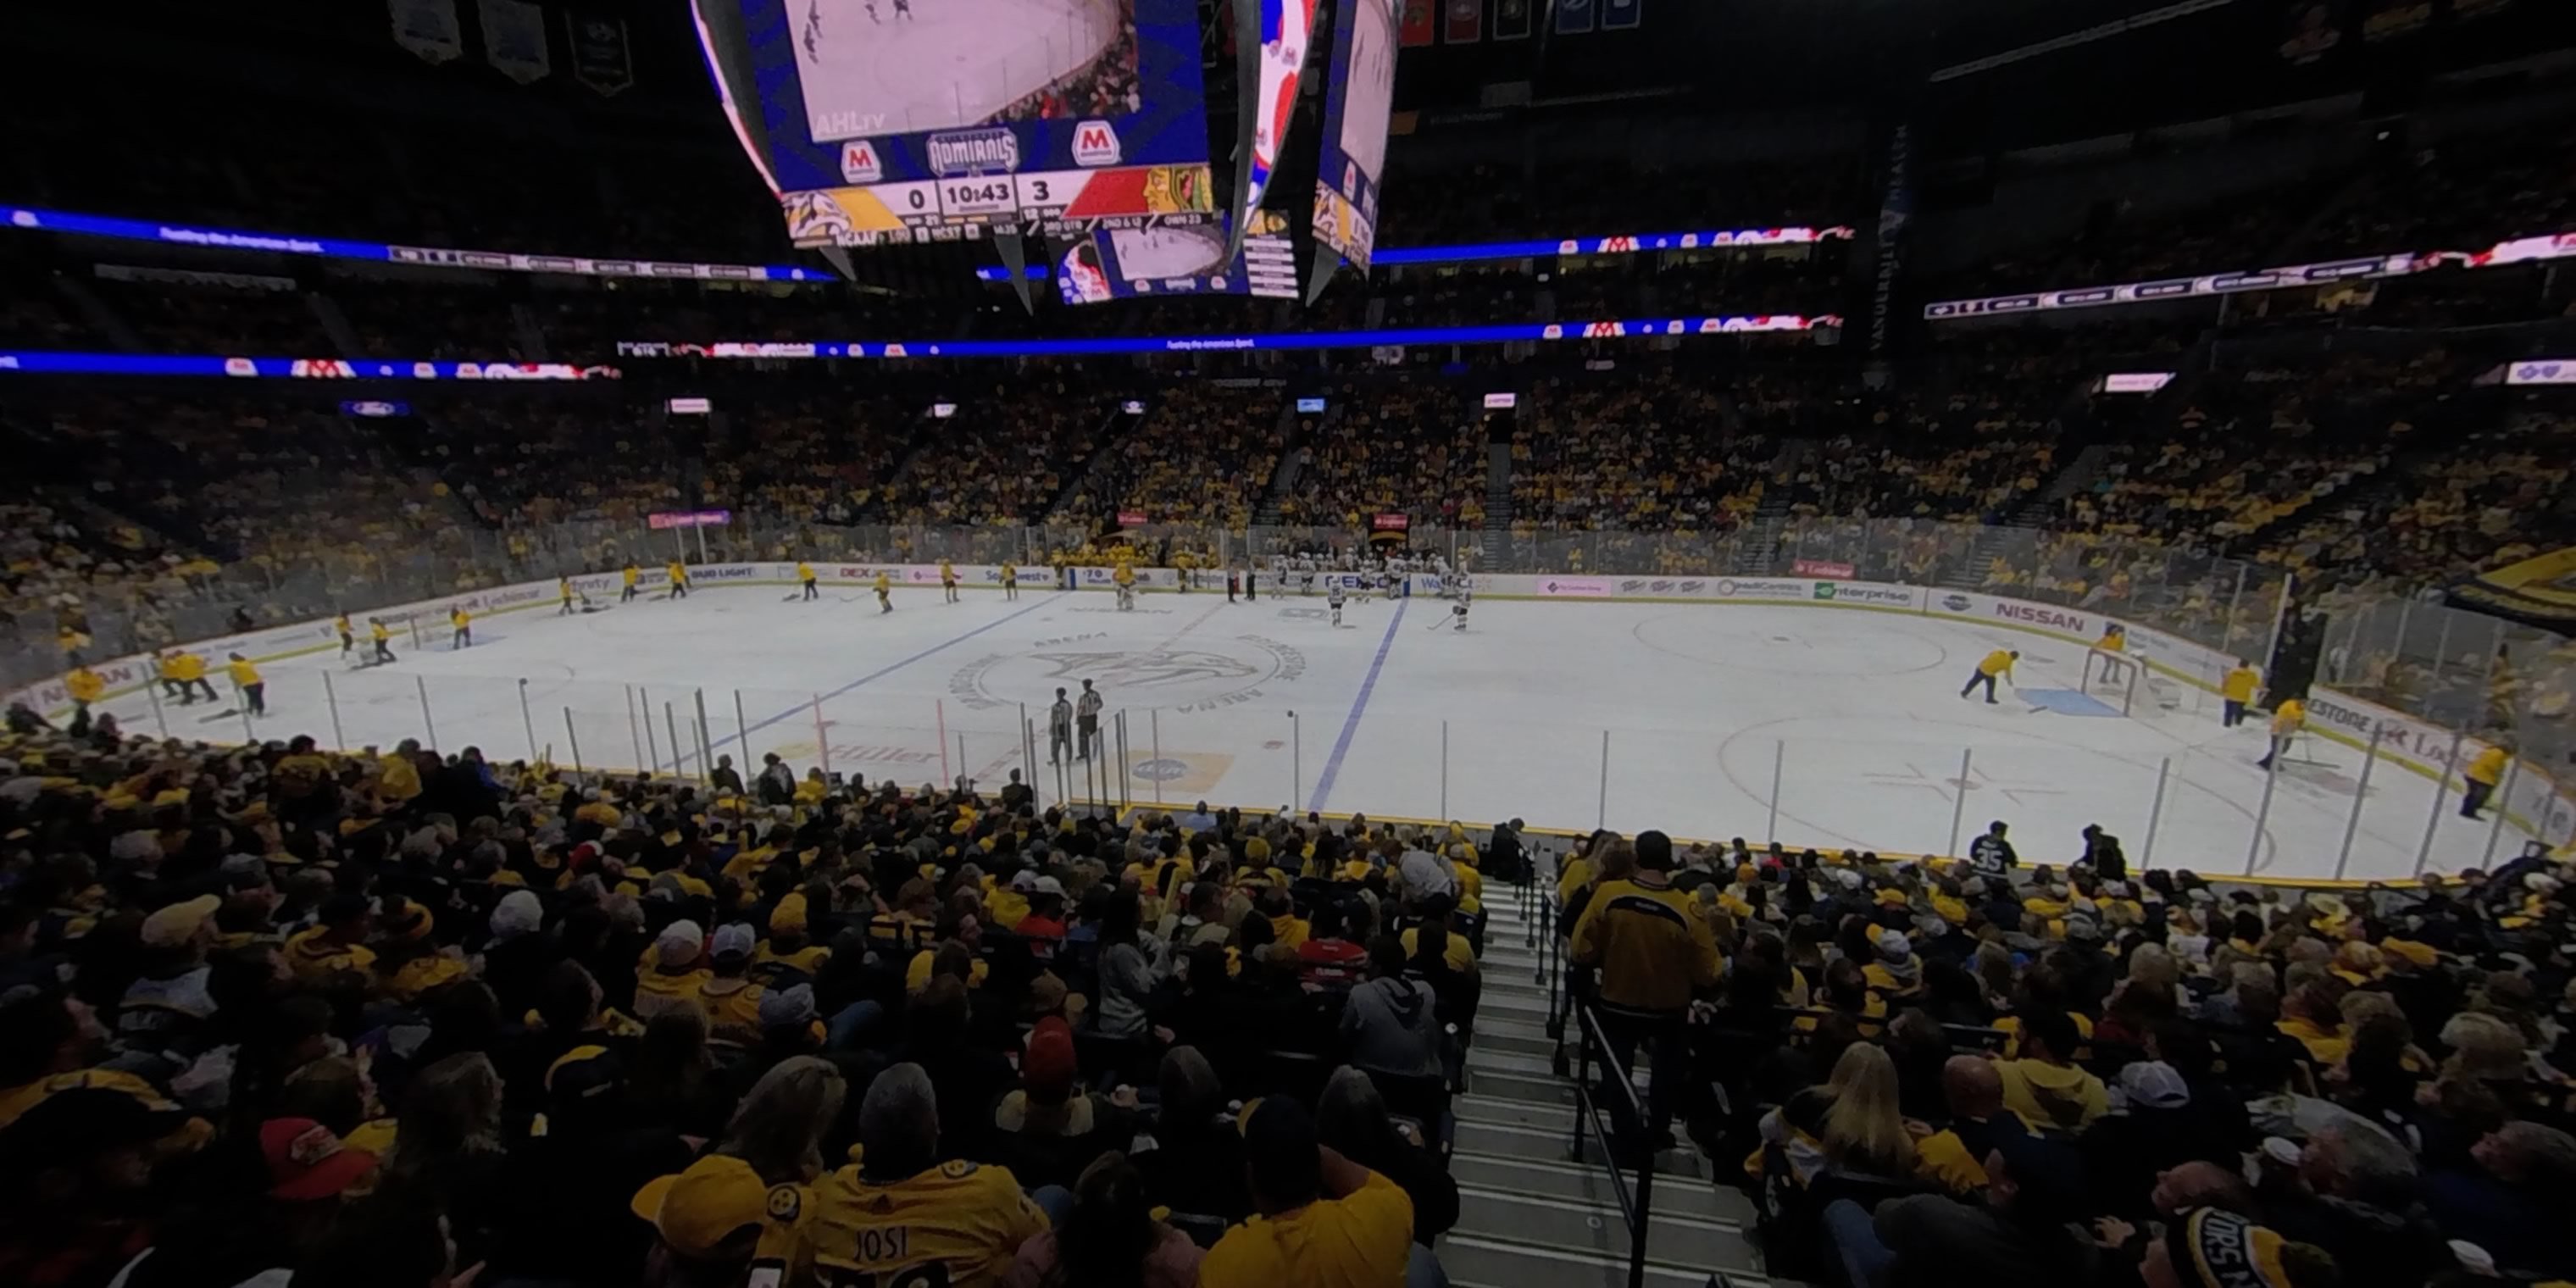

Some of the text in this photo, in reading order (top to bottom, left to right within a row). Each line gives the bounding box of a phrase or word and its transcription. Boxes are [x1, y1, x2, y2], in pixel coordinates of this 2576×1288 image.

[929, 136, 1017, 175] ADMIRALS
[908, 189, 925, 209] 0
[947, 183, 1010, 204] 10:43
[1032, 180, 1050, 201] 3
[840, 568, 869, 578] DEX
[1996, 602, 2085, 632] NISSAN
[1975, 847, 2004, 872] 35
[854, 1225, 908, 1262] JOSI
